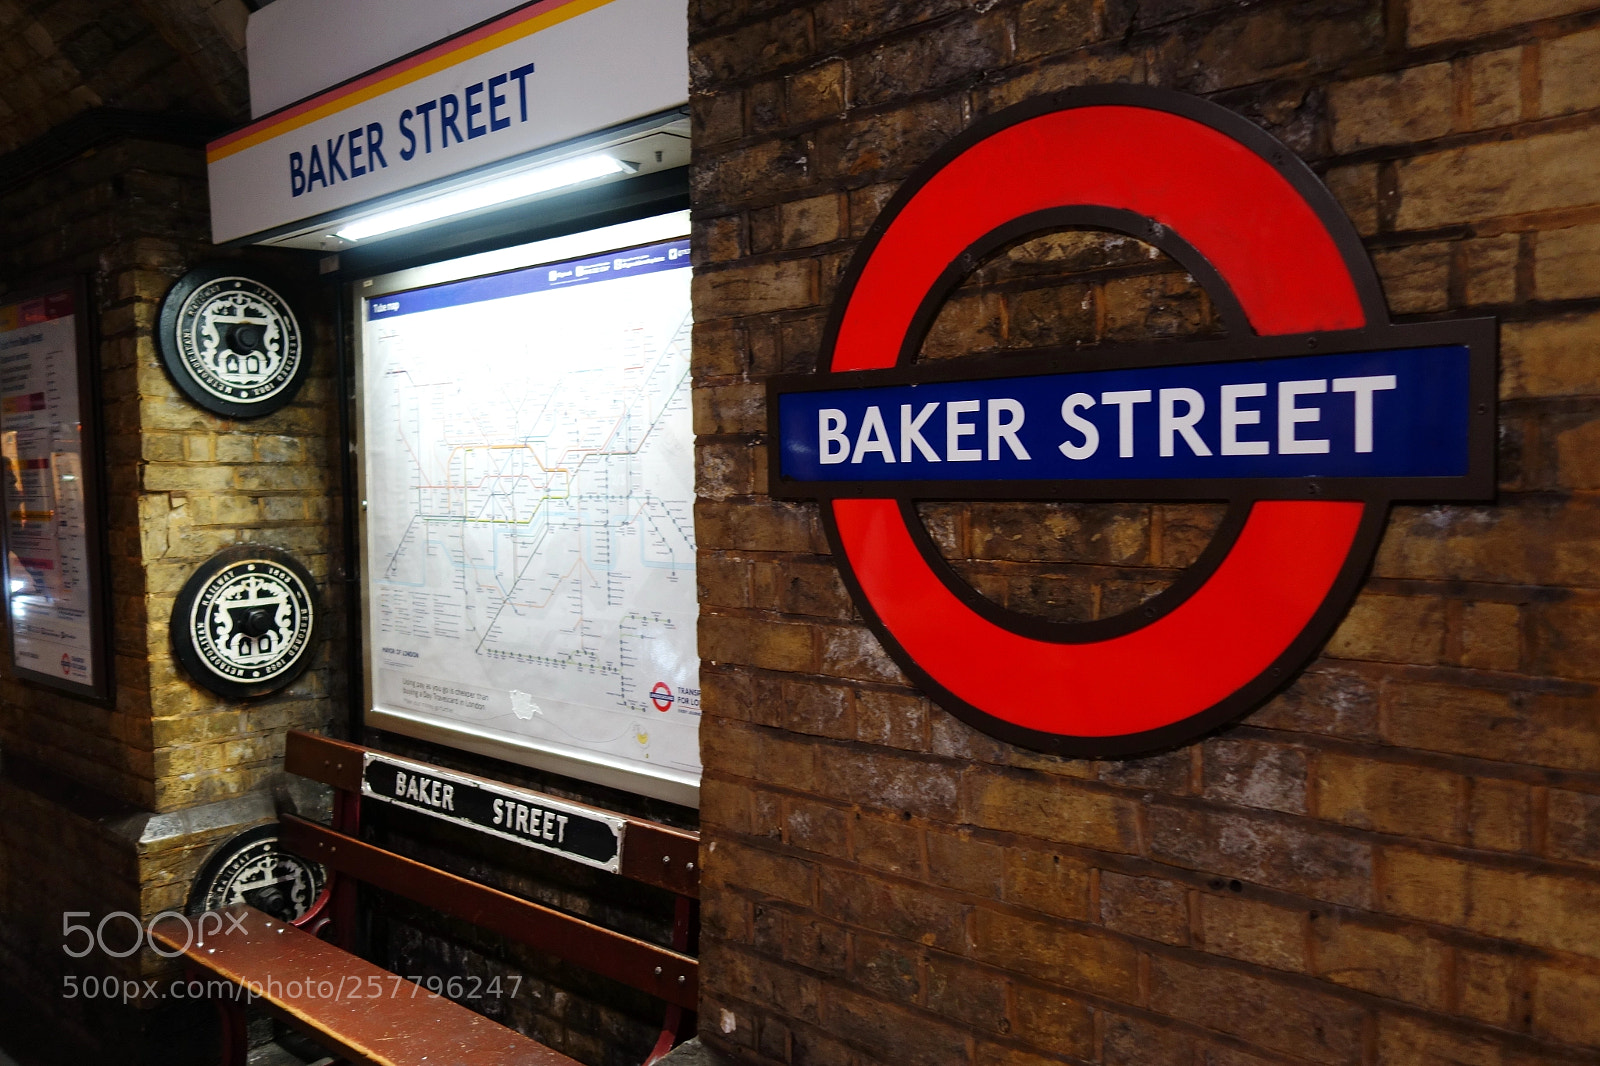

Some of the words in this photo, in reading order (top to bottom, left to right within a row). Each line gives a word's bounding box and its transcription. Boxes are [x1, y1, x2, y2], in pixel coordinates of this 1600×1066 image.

[289, 121, 389, 197] BAKER
[399, 62, 535, 162] STREET
[818, 397, 1032, 465] BAKER
[1057, 374, 1398, 460] STREET
[201, 570, 236, 607] RAILWAY
[196, 622, 245, 678] METROPOLITAN
[288, 608, 309, 657] RESTORED
[395, 771, 455, 812] BAKER
[492, 798, 569, 844] STREET
